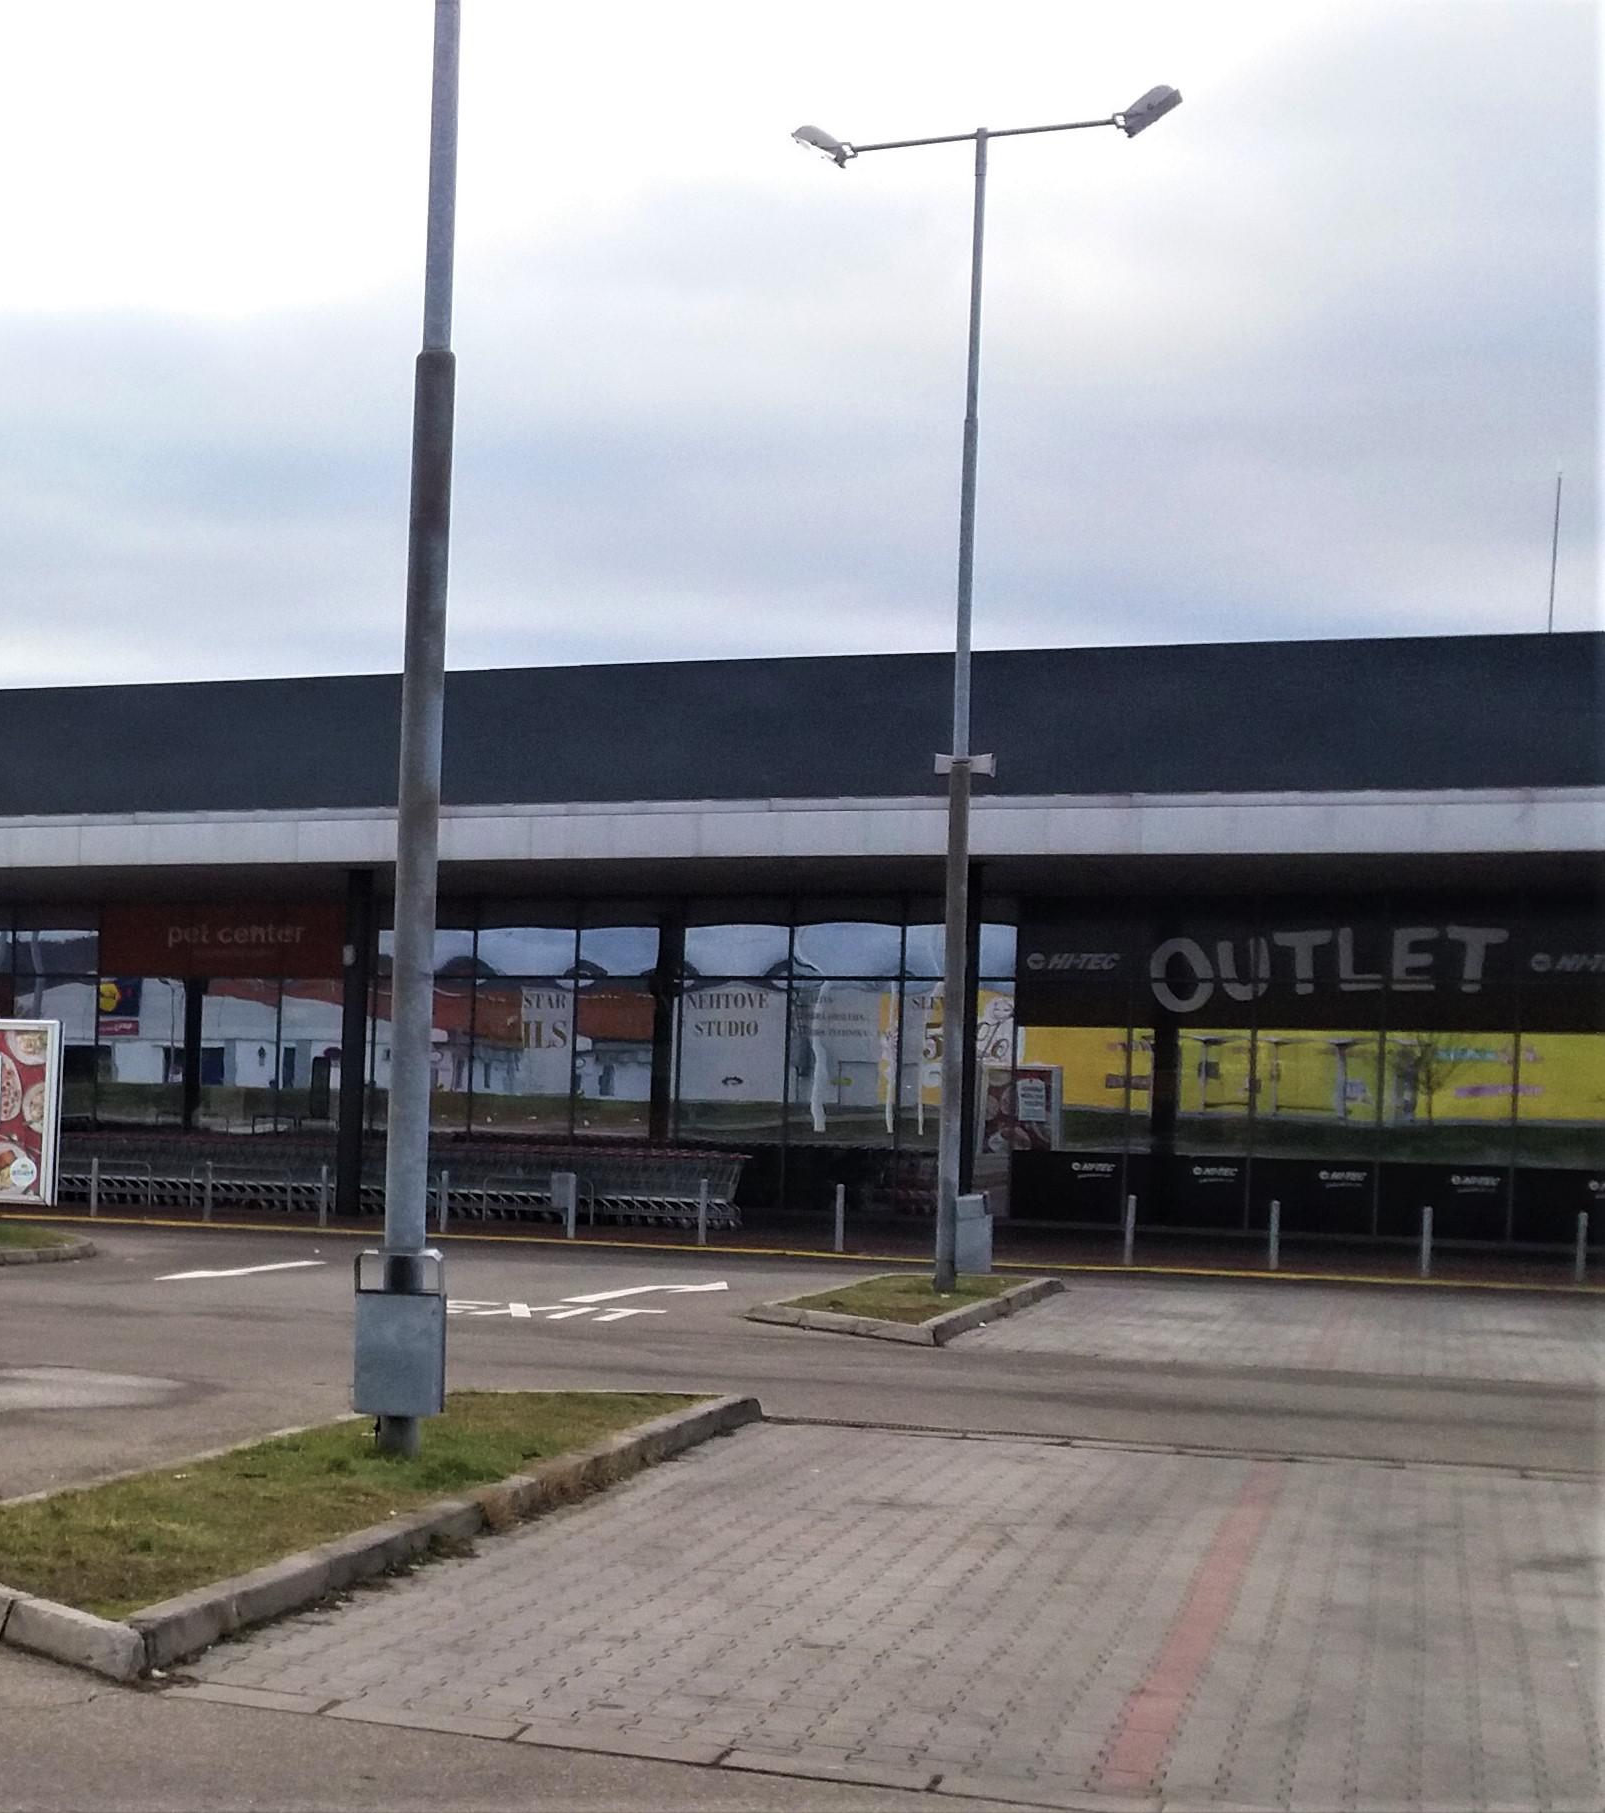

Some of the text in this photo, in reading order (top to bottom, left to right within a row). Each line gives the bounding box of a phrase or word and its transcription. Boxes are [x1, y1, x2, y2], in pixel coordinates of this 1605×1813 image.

[168, 923, 306, 949] pet center
[1047, 952, 1121, 971] HI-TEC
[1150, 926, 1510, 1013] OUTLET
[694, 1020, 759, 1037] STUDIO
